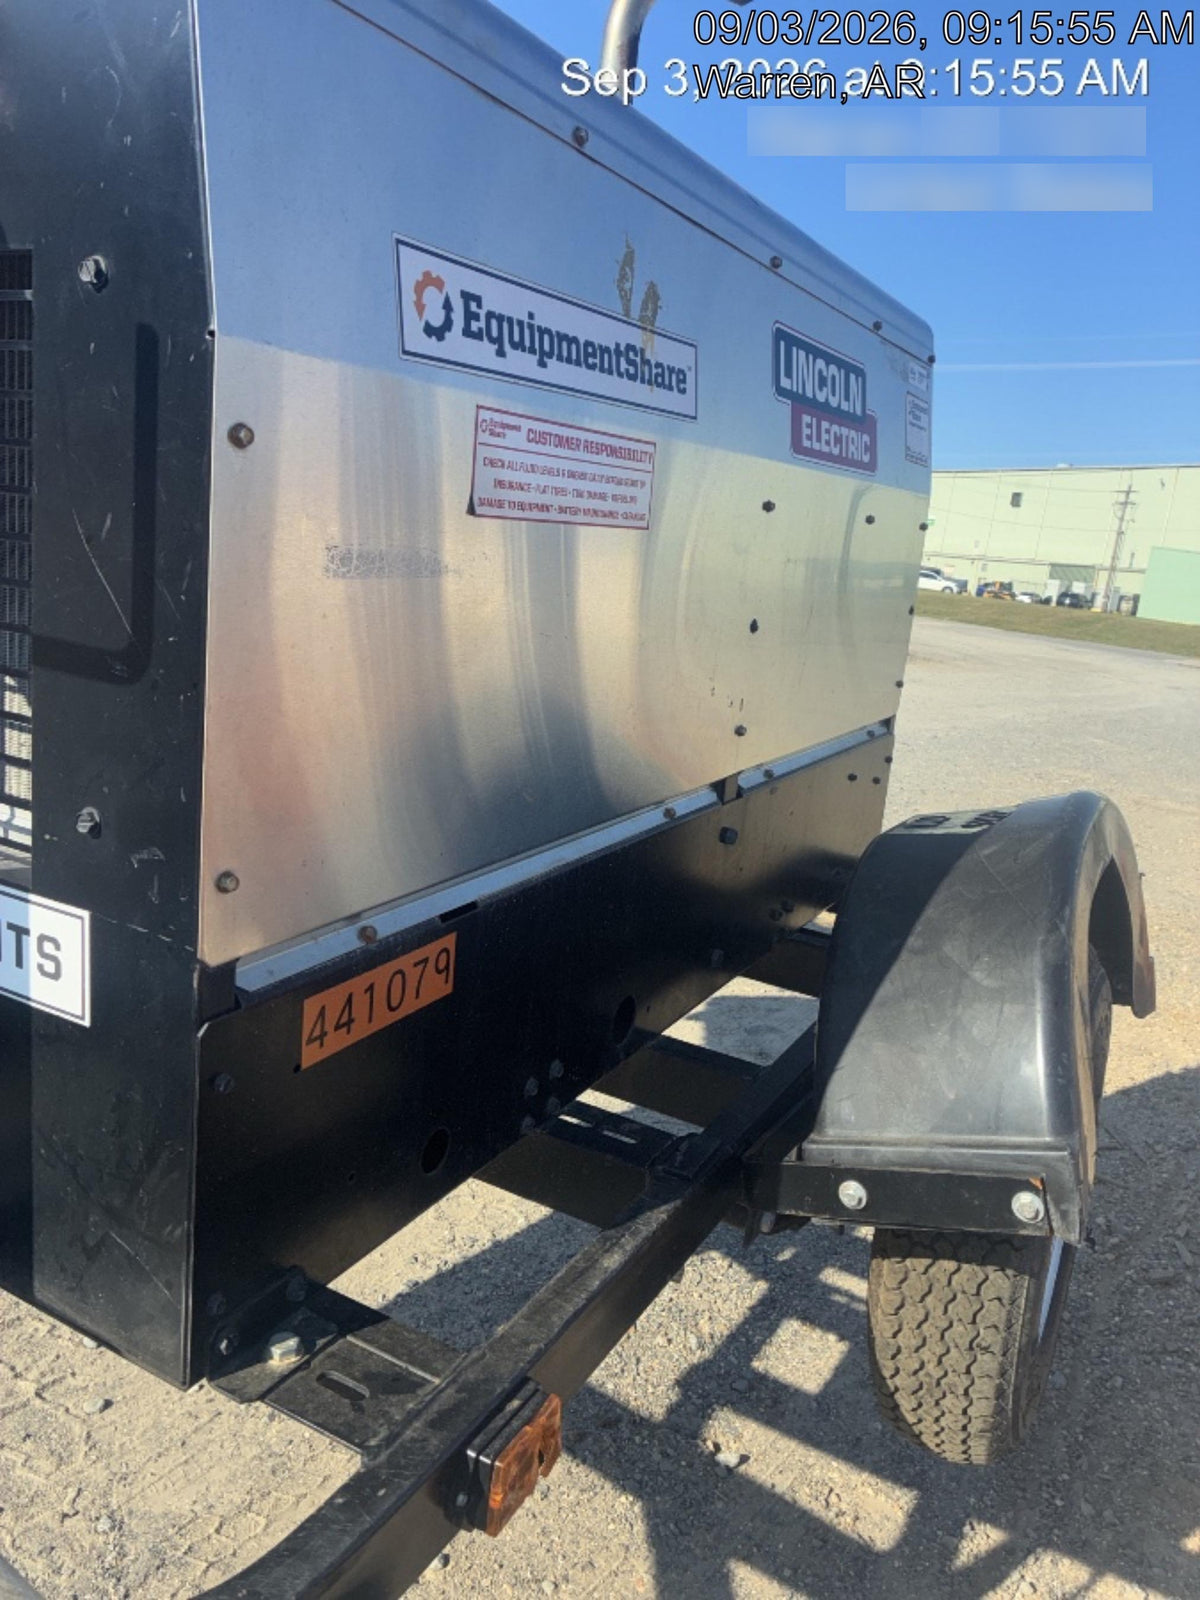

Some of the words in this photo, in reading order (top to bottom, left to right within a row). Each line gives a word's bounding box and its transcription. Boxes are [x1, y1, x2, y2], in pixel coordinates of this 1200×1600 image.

[459, 289, 688, 395] EquipmentShare
[779, 340, 863, 417] LINCOLN
[526, 427, 582, 452] CUSTOMER
[582, 438, 653, 465] RESPONSIBILITY
[801, 413, 871, 464] ELECTRIC
[0, 918, 62, 982] TS
[305, 947, 451, 1049] 441079
